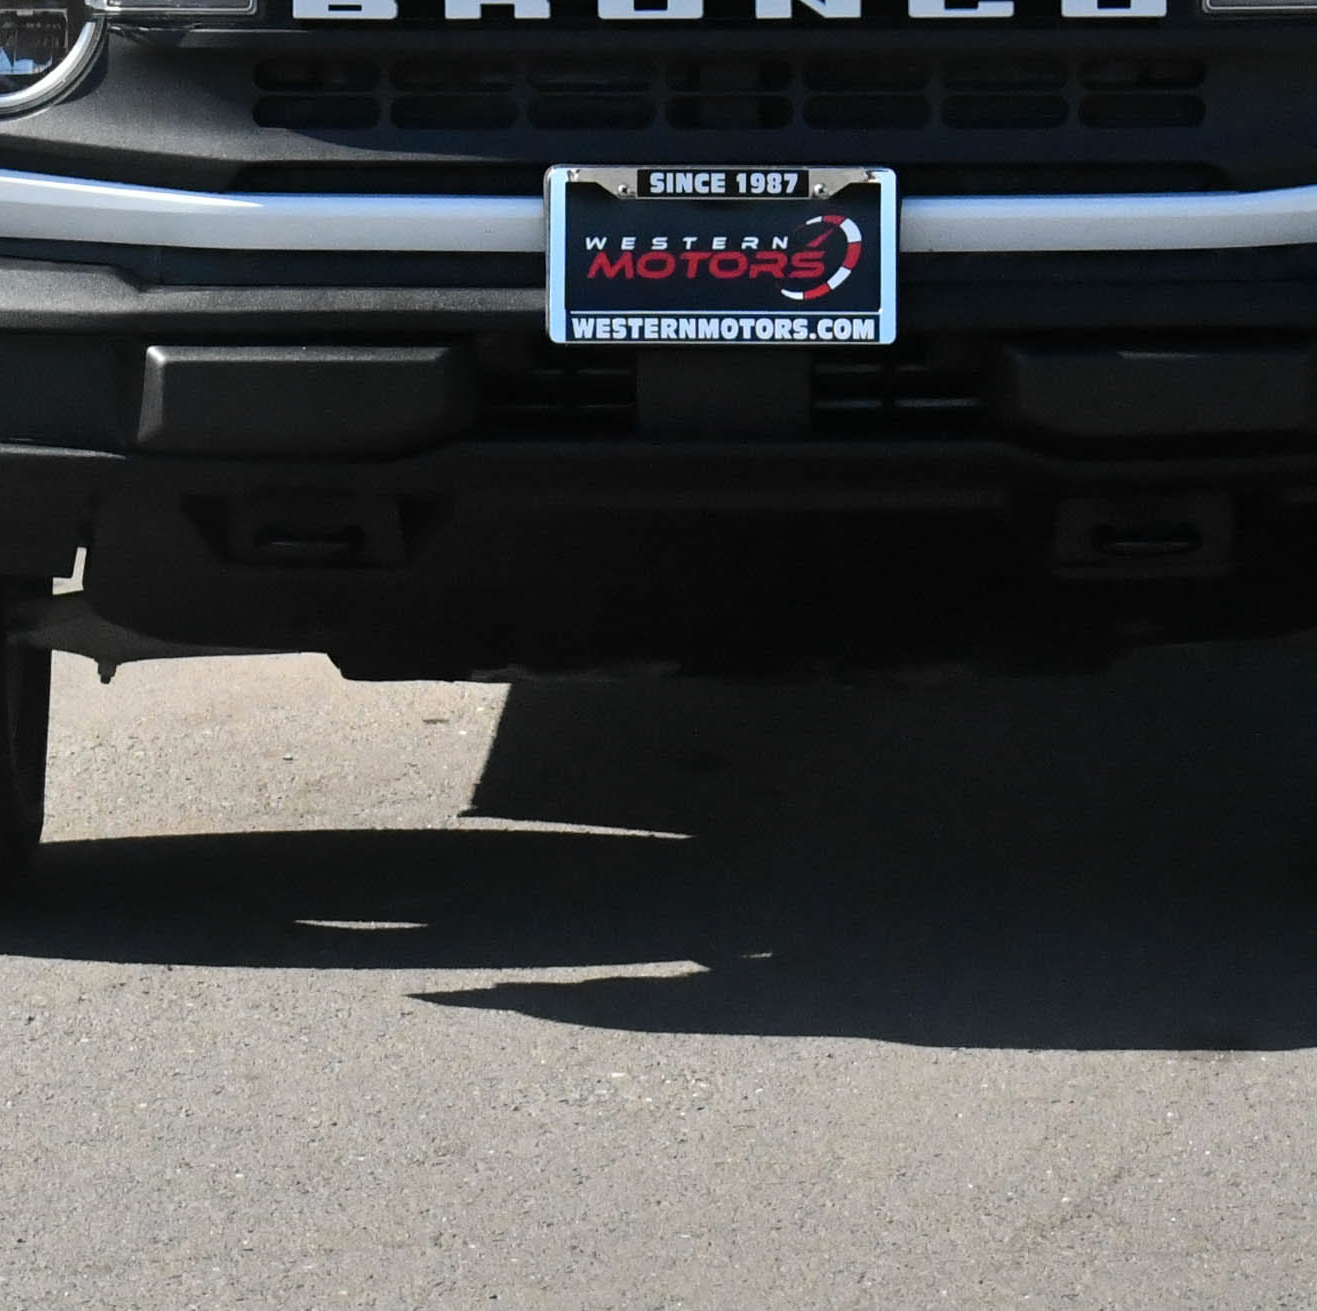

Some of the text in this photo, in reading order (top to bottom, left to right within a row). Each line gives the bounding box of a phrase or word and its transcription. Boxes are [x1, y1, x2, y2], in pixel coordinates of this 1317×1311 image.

[649, 172, 799, 194] SINCE 1987
[585, 236, 789, 250] WESTERN
[587, 250, 826, 279] MOTORS
[571, 317, 875, 340] WESTERNMOTORS.COM
